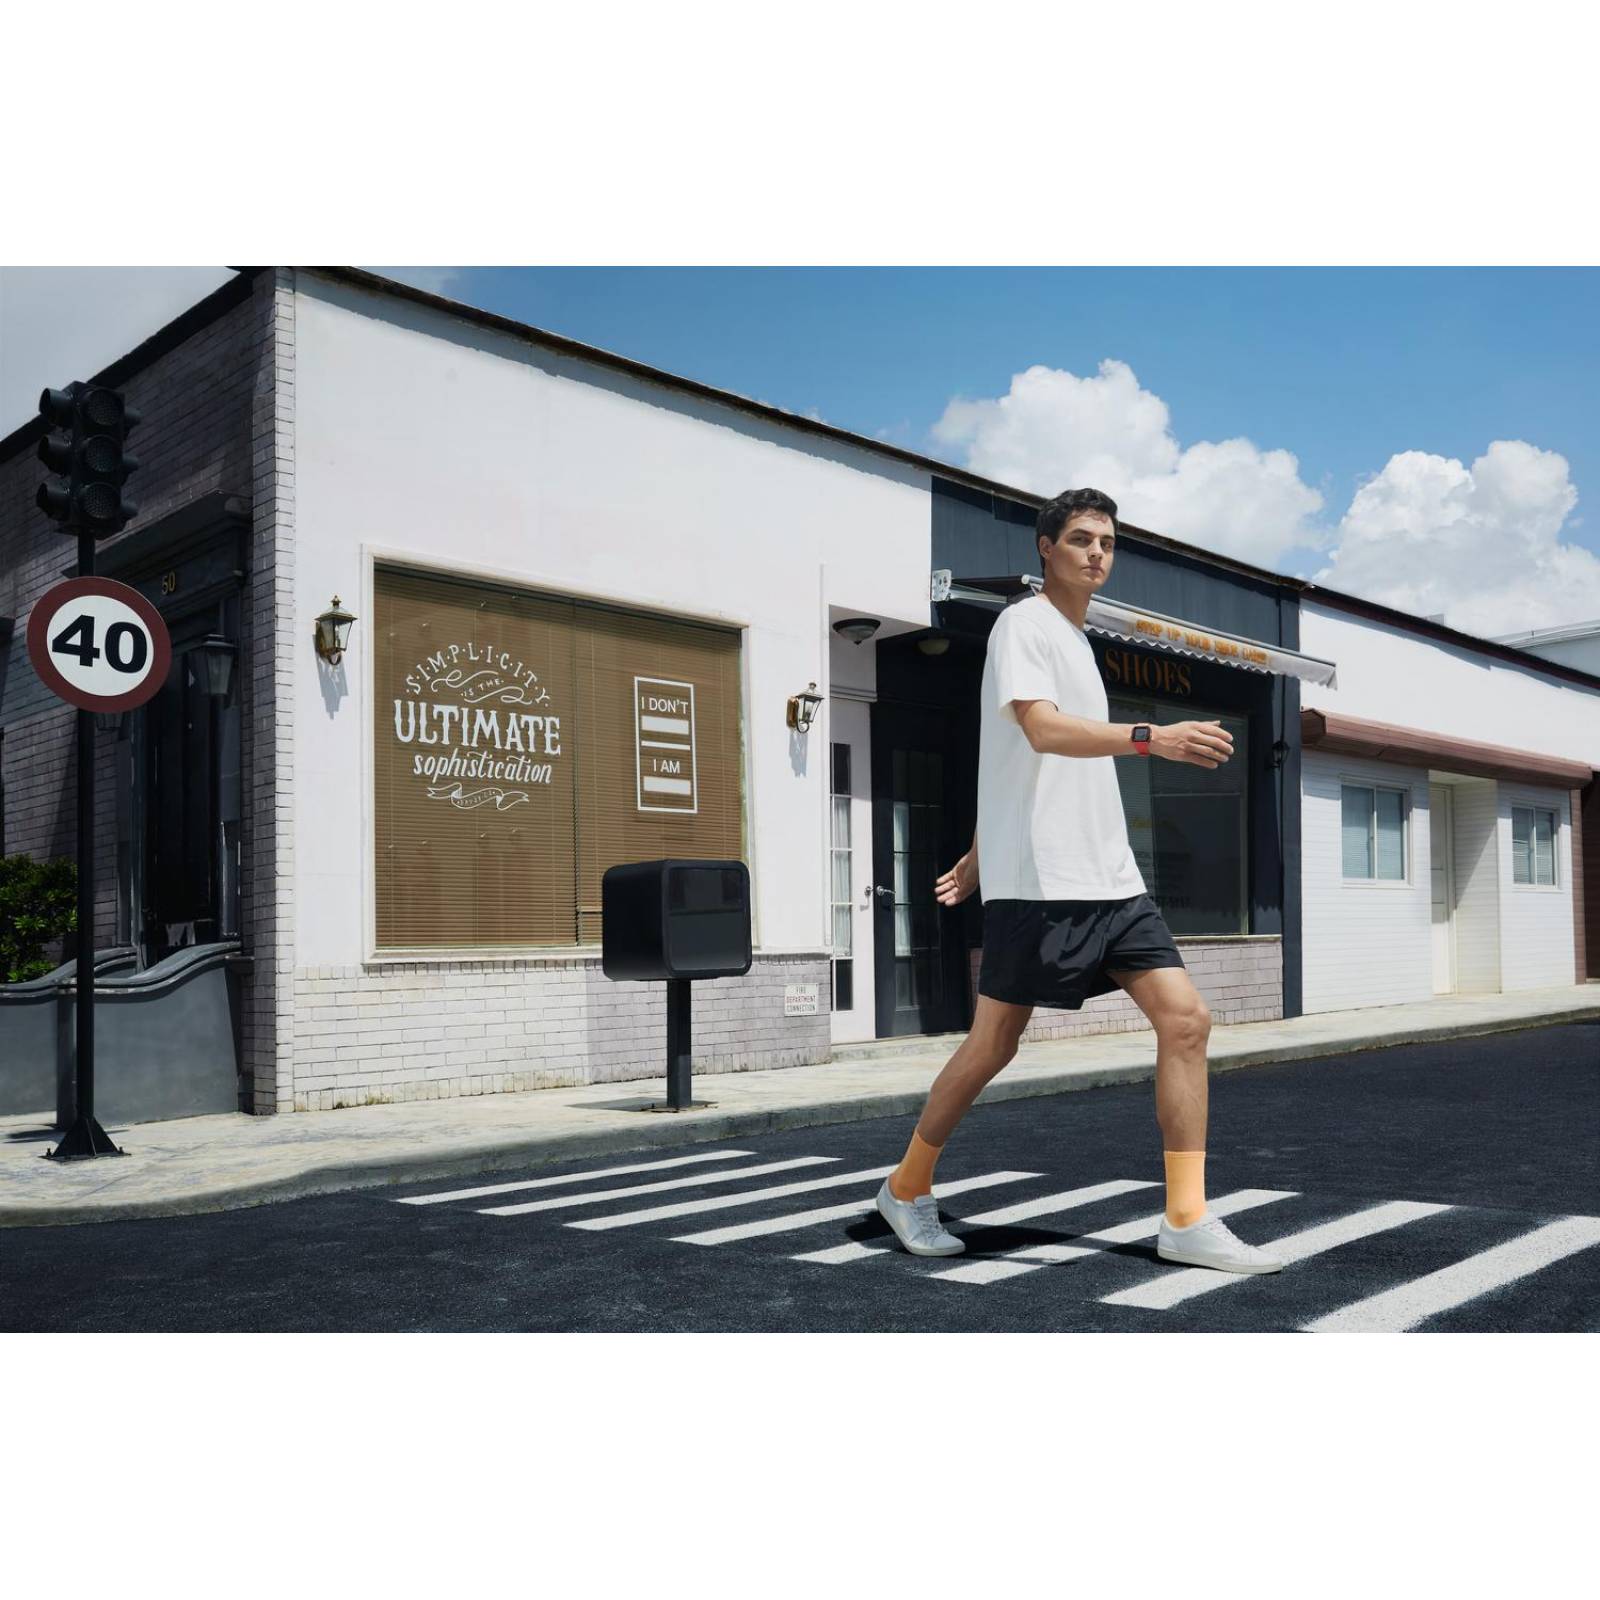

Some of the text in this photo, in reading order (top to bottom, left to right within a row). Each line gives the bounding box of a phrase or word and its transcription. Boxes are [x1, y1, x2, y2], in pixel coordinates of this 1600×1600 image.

[160, 570, 176, 595] 50
[52, 614, 148, 673] 40
[478, 678, 500, 691] THE
[1104, 647, 1192, 697] SHOES
[649, 697, 689, 714] DON'T
[394, 699, 561, 756] ULTIMATE
[413, 748, 553, 784] sophistication
[660, 759, 681, 774] AM
